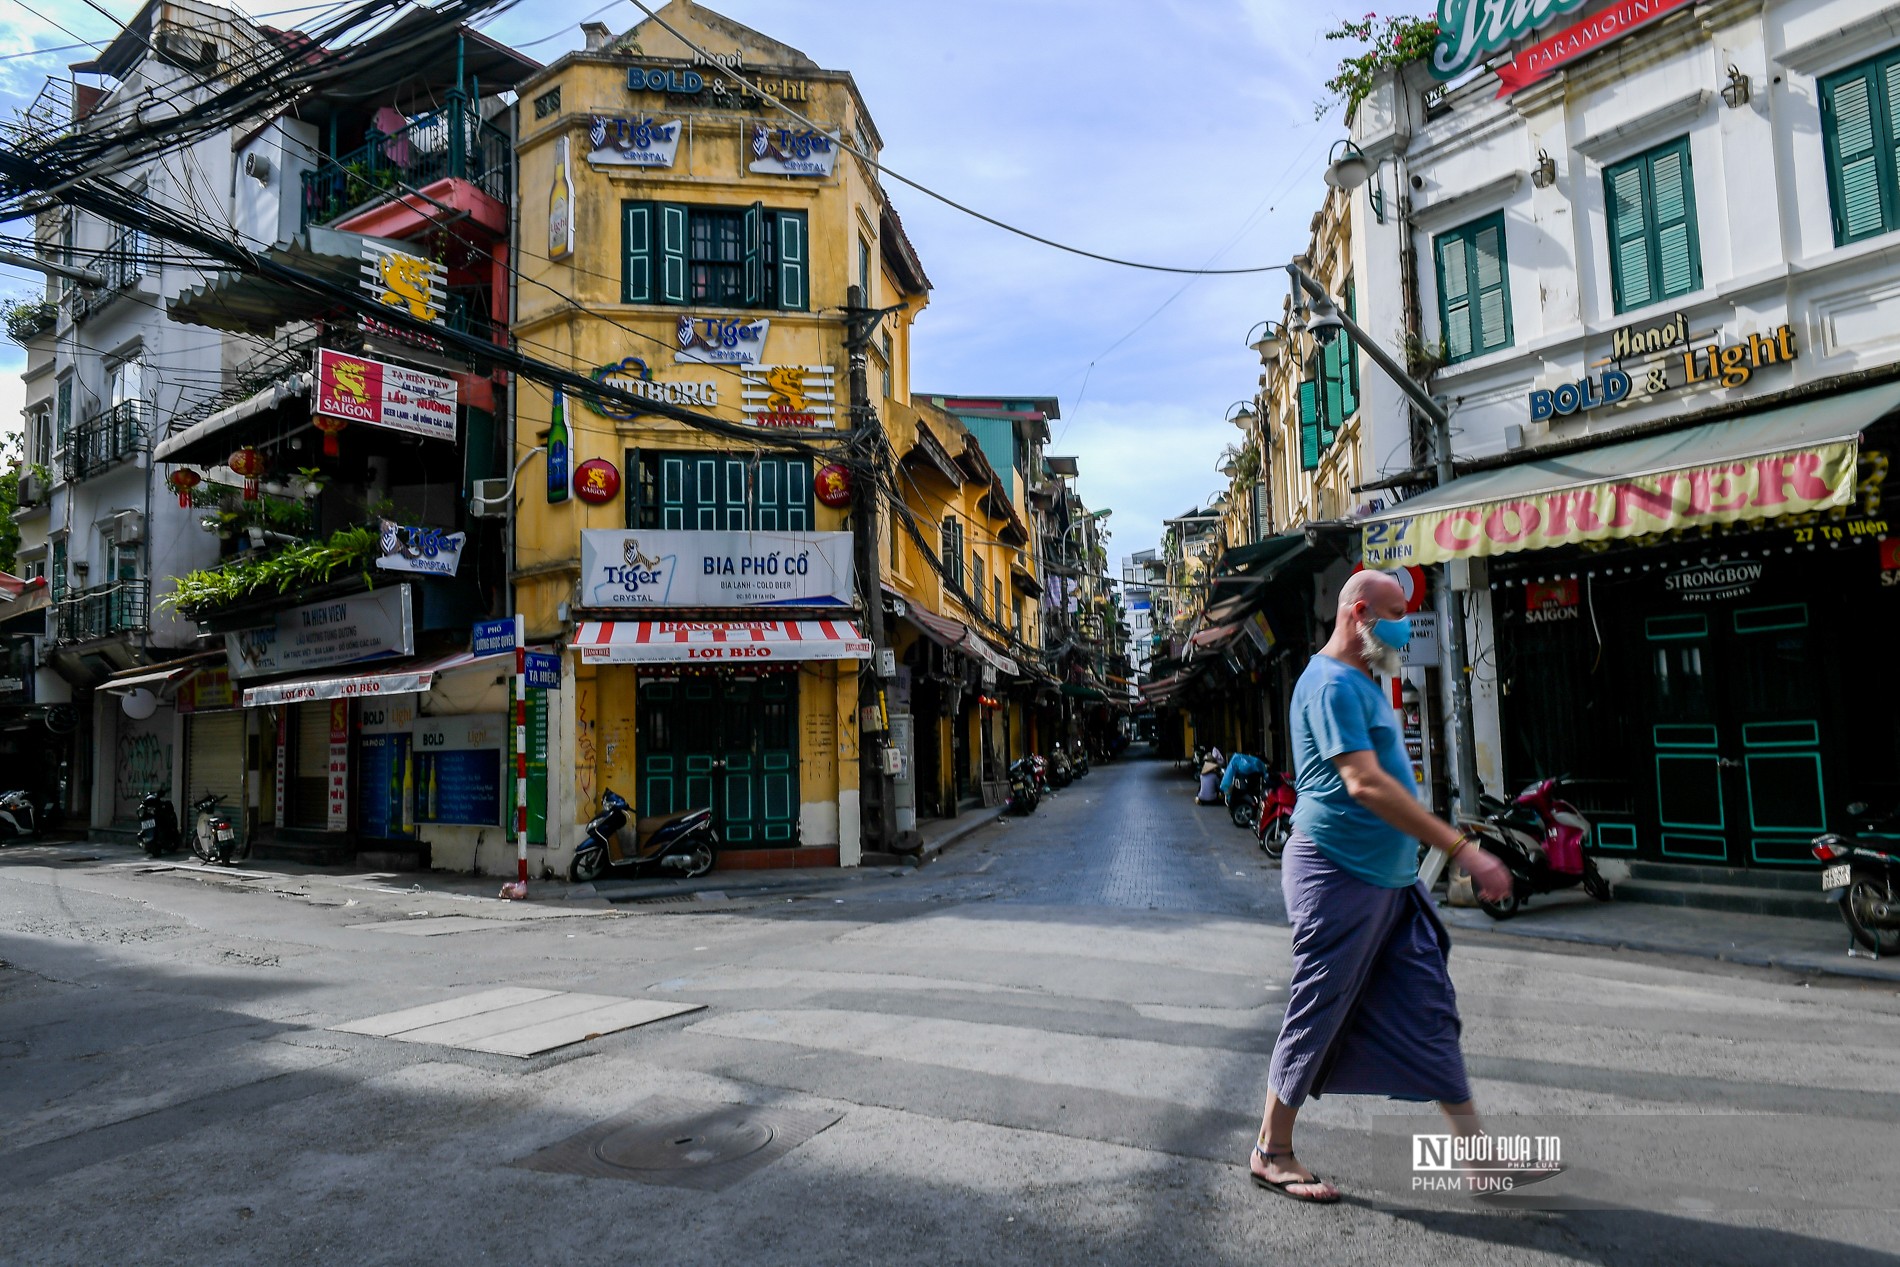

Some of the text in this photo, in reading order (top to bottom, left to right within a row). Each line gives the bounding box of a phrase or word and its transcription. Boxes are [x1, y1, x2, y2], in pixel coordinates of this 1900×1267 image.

[627, 67, 704, 94] BOLD
[713, 77, 727, 95] &
[741, 77, 807, 107] Light
[612, 118, 676, 149] Tiger
[776, 128, 832, 160] Tiger
[623, 151, 667, 163] CRYSTAL
[783, 161, 826, 173] CRYSTAL
[701, 317, 763, 349] Tiger
[1613, 311, 1688, 359] Hanoi
[709, 350, 753, 362] CRYSTAL
[1529, 324, 1795, 423] BOLD & Light
[428, 380, 449, 390] VIEW
[341, 395, 356, 405] BIA
[324, 400, 373, 419] SAIGON
[756, 412, 816, 427] SAIGON
[1434, 453, 1834, 551] CORNER
[1367, 517, 1413, 545] 27
[1793, 527, 1814, 543] 27
[1820, 525, 1843, 542] Tạ
[404, 525, 461, 558] Tiger
[410, 559, 452, 572] CRYSTAL
[704, 557, 735, 576] BIA
[742, 552, 780, 576] PHỐ
[603, 565, 662, 593] Tiger
[756, 581, 774, 589] COLD
[1665, 563, 1763, 592] STRONGBOW
[612, 594, 654, 603] CRYSTAL
[1682, 586, 1752, 602] APPLE CIDERS
[329, 603, 347, 622] VIEW
[1525, 606, 1579, 623] SAIGON
[664, 622, 724, 632] HANOI
[730, 644, 772, 657] BÉO
[529, 669, 538, 684] TẠ
[363, 711, 384, 726] BOLD
[423, 733, 444, 746] BOLD
